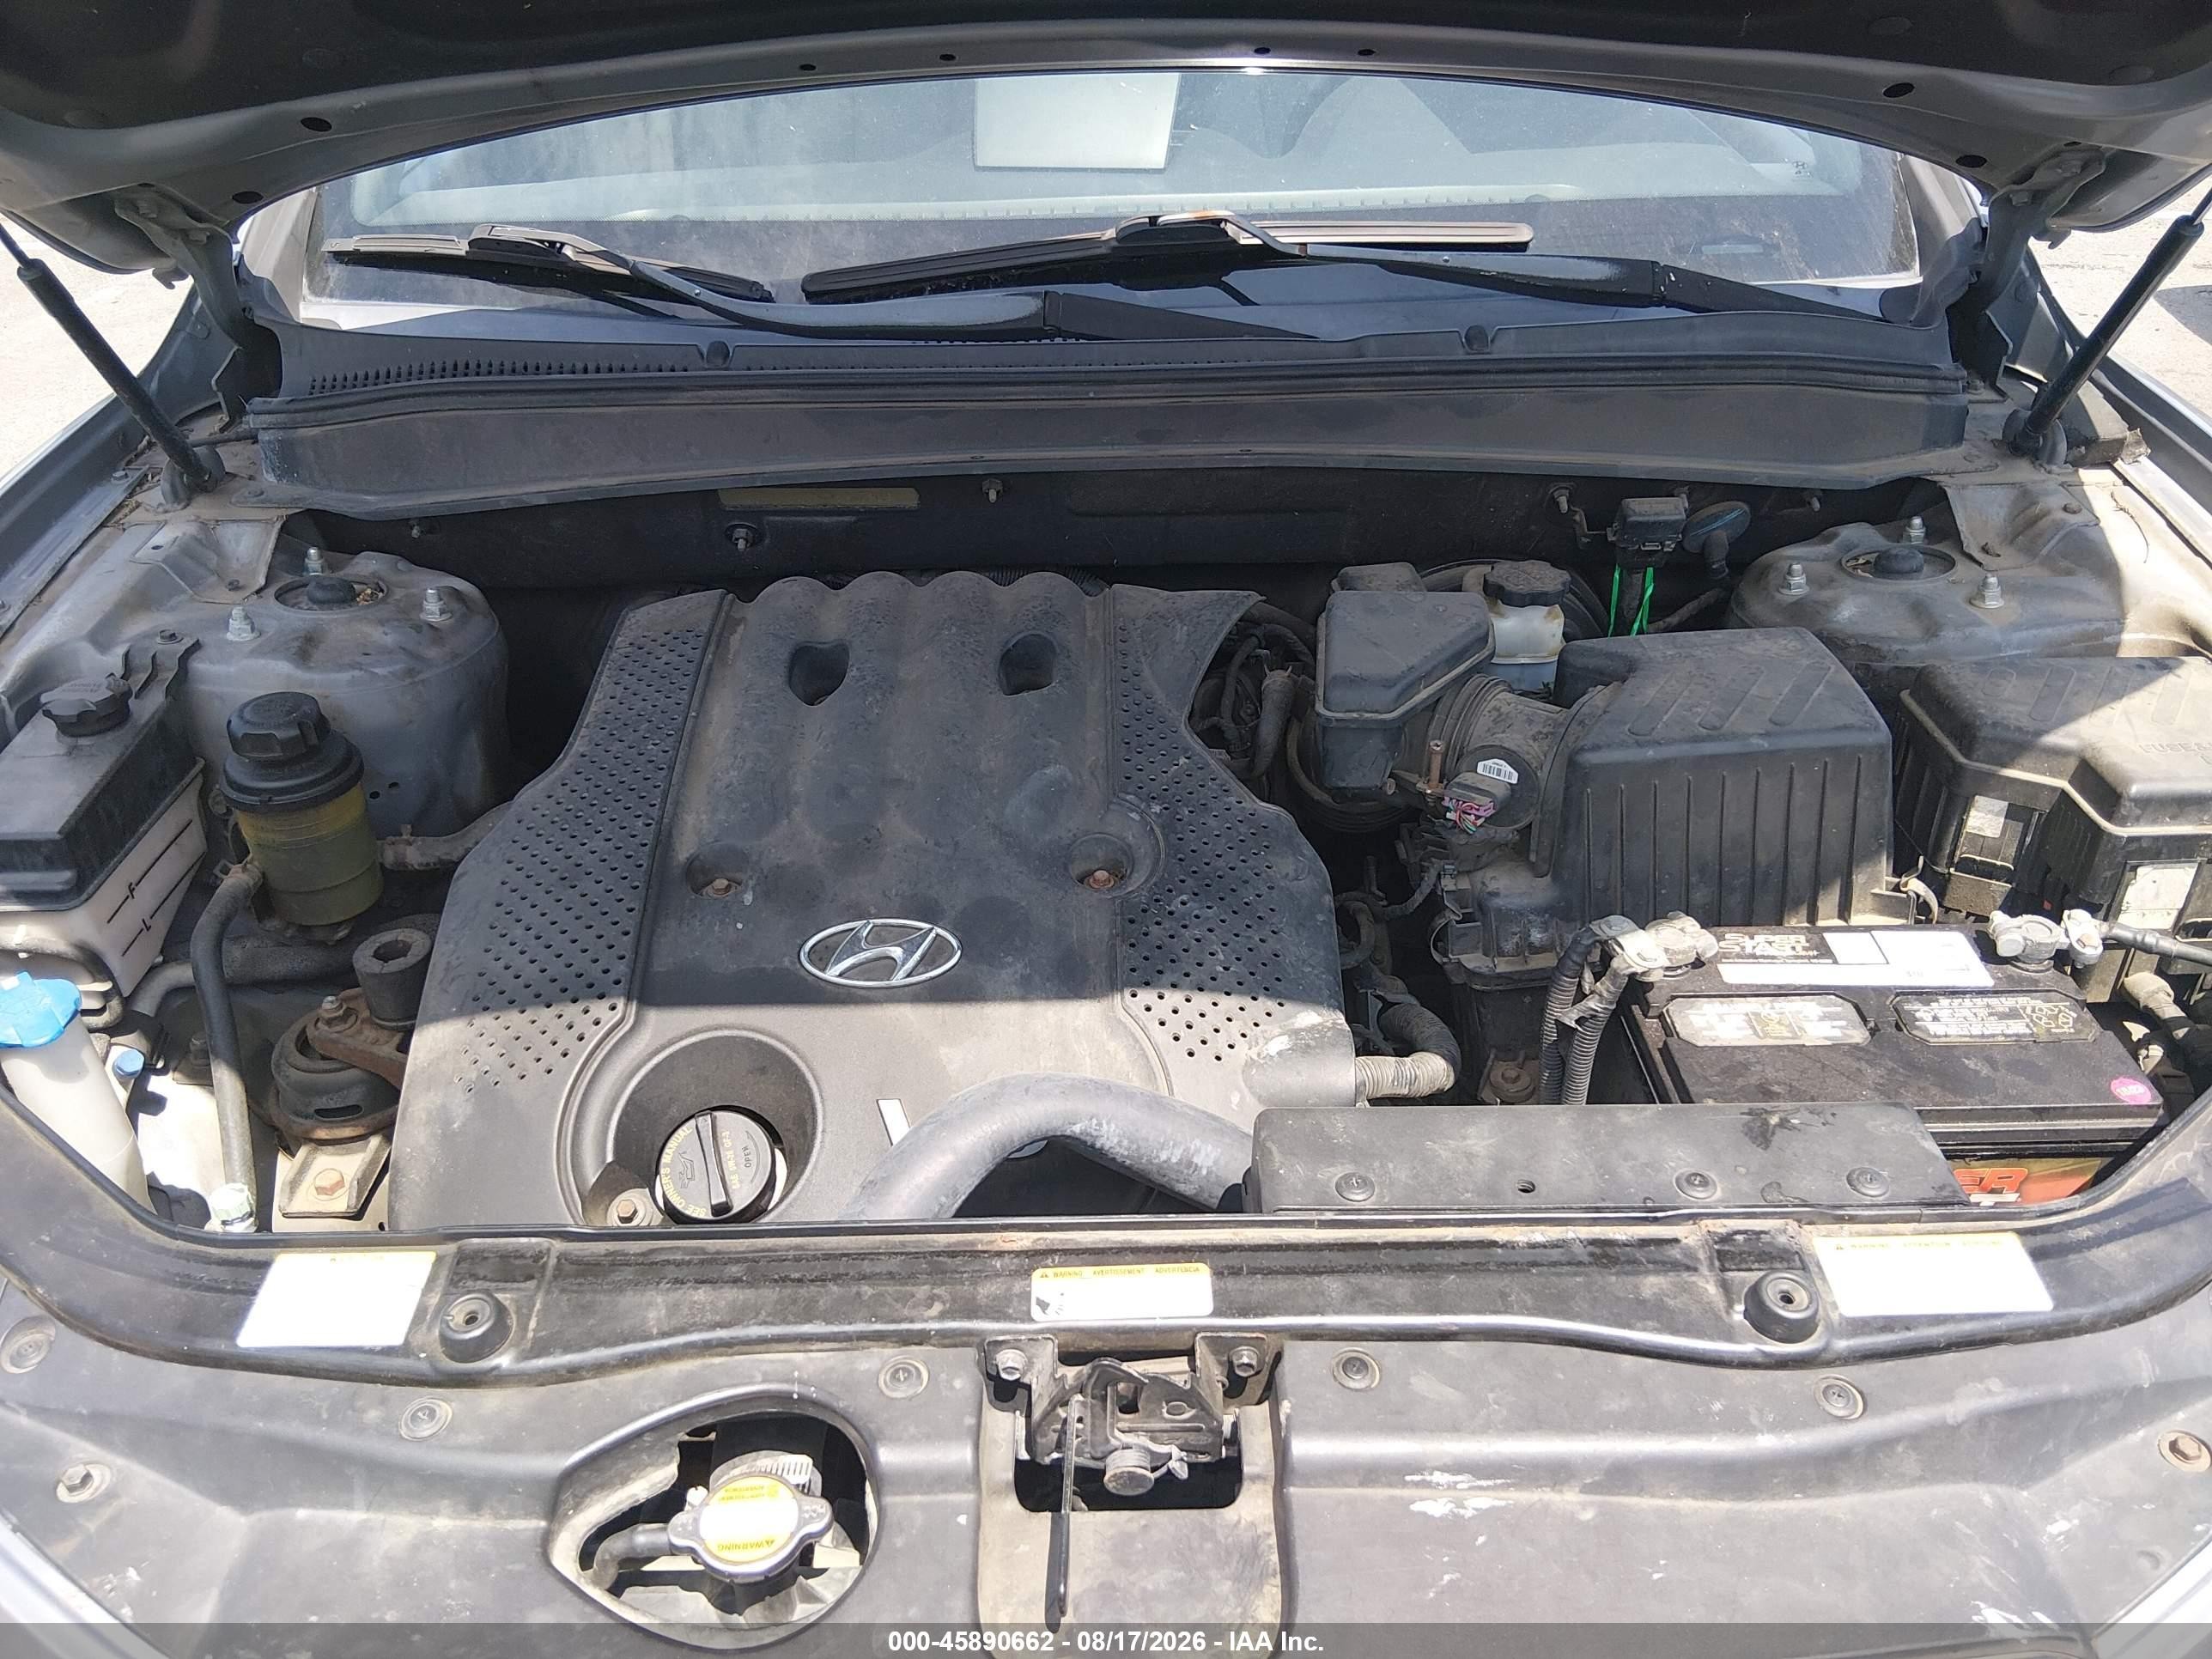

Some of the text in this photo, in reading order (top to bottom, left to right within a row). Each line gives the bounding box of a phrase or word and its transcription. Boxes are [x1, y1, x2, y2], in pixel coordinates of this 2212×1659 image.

[127, 881, 136, 899] F
[141, 917, 152, 932] L
[664, 1126, 693, 1164] MANUAL
[742, 1146, 751, 1168] OPEN
[686, 1204, 707, 1217] SEE
[1053, 1270, 1084, 1279] WARNING
[716, 1540, 765, 1553] WARNING
